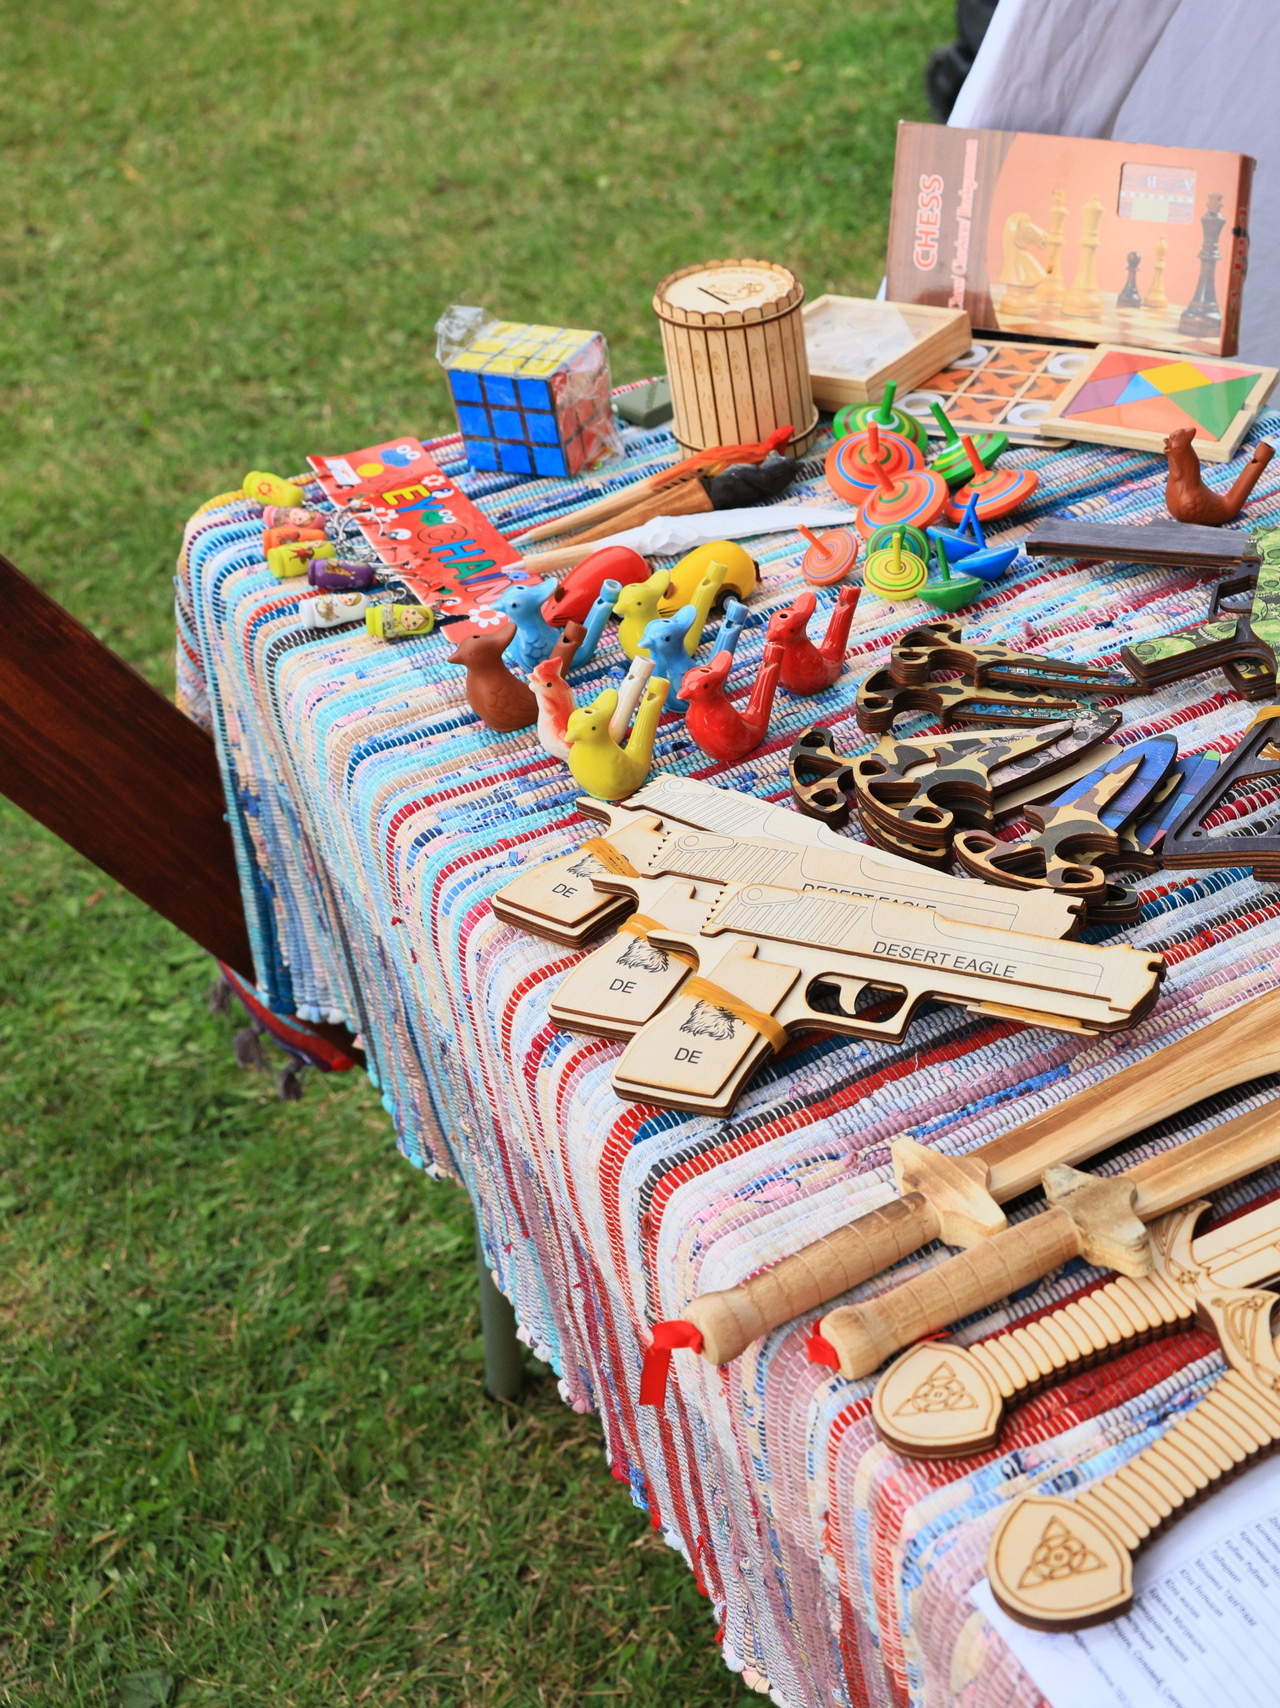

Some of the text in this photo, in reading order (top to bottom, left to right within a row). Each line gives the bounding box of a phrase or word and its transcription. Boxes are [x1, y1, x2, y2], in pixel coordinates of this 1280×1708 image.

[913, 173, 944, 271] CHESS
[552, 883, 577, 898] DE
[870, 941, 1015, 980] DESERT EAGLE
[609, 978, 636, 994] DE
[674, 1047, 702, 1064] DE
